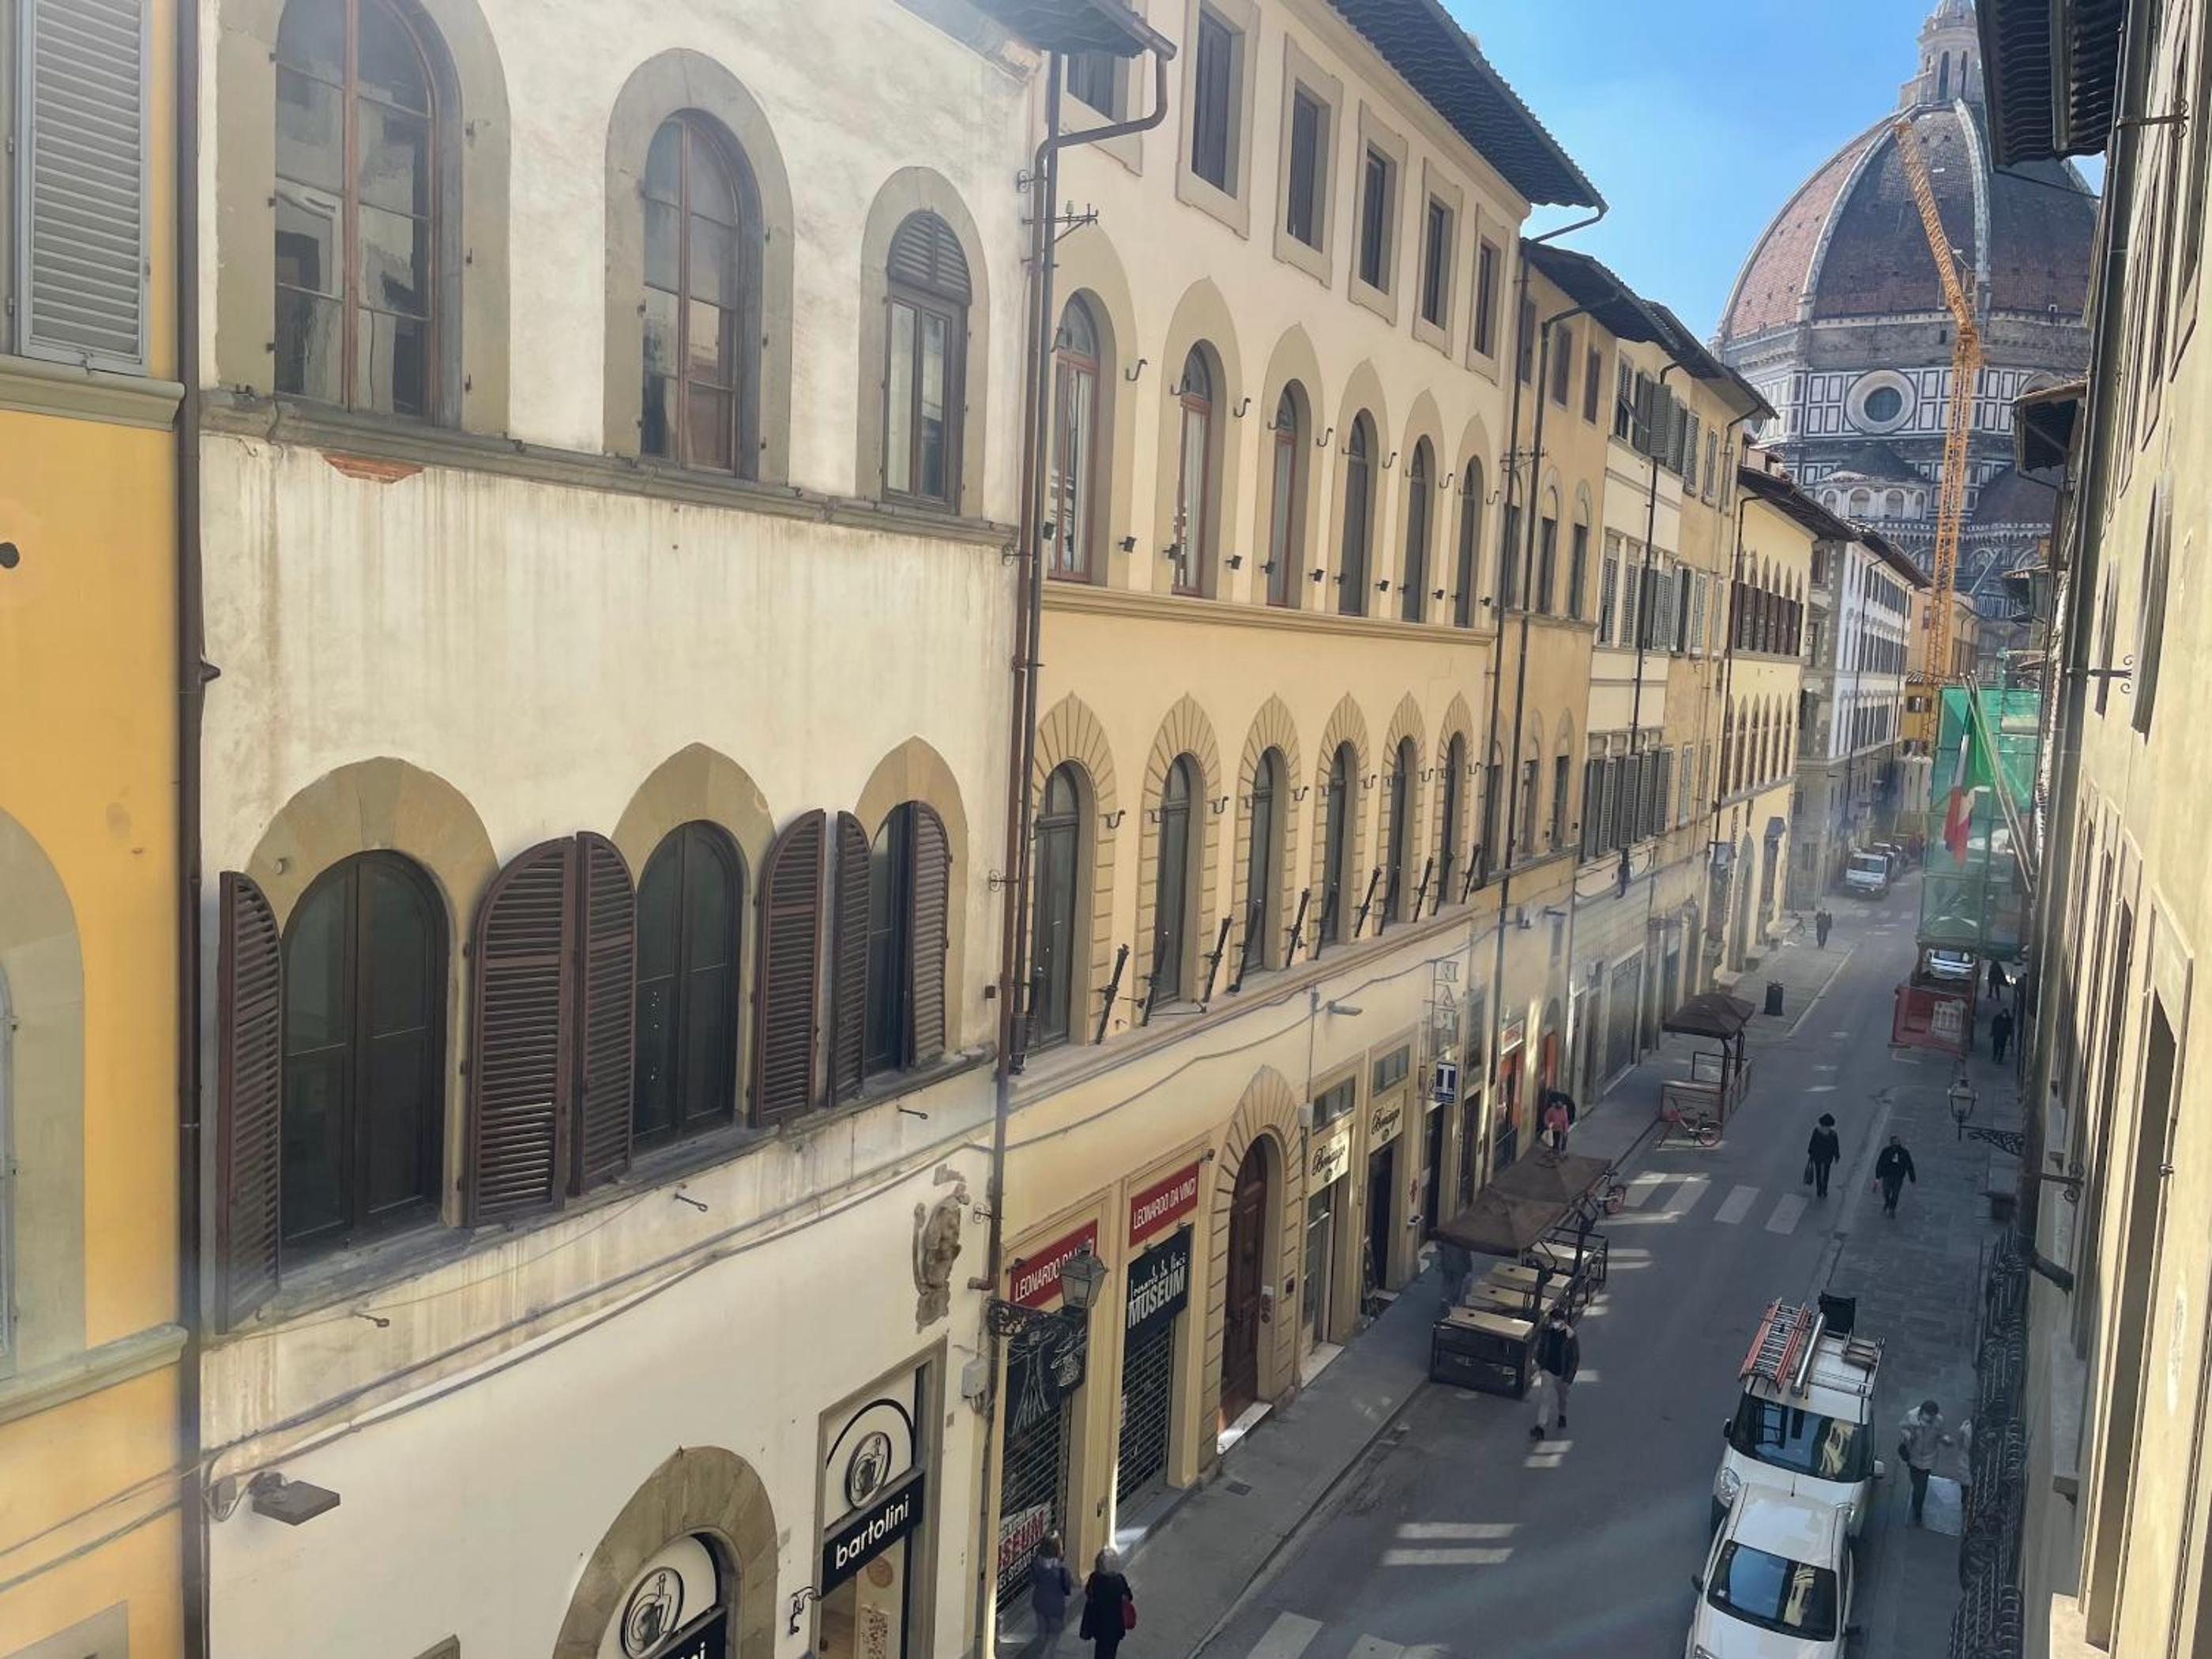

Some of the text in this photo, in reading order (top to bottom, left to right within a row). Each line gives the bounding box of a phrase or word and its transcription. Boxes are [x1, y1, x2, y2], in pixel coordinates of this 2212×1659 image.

[1437, 1063, 1456, 1094] T
[1134, 1176, 1197, 1229] LEONARDO DA VINCI
[1015, 1258, 1059, 1302] LEONARDO
[1127, 1265, 1185, 1330] MUSEUM
[836, 1493, 909, 1571] bartolini
